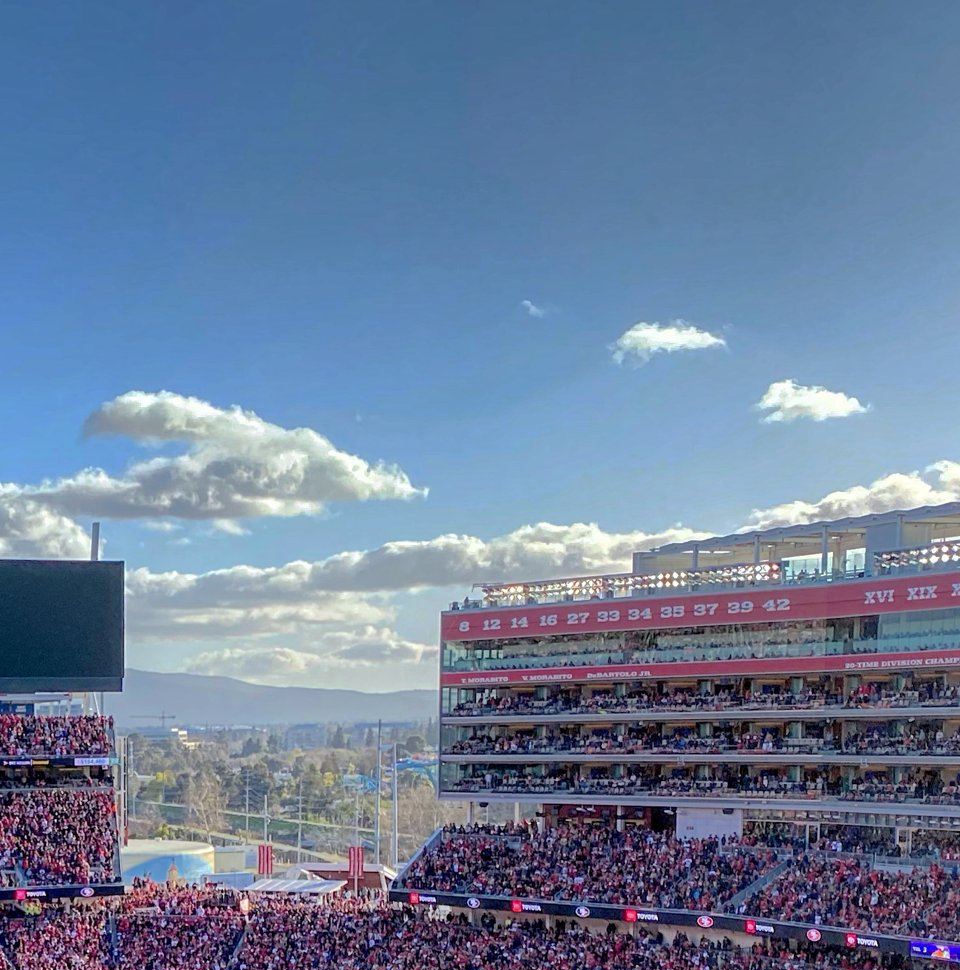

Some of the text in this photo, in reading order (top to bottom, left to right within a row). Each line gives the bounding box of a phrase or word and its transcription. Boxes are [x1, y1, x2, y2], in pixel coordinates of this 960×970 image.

[864, 589, 895, 604] XVI
[907, 585, 938, 600] XIX
[458, 598, 791, 632] 8 12 14 16 27 33 34 35 37 39 42
[881, 659, 923, 667] DIVISION
[637, 913, 659, 921] TOYOTA
[856, 937, 879, 948] TOYOTA
